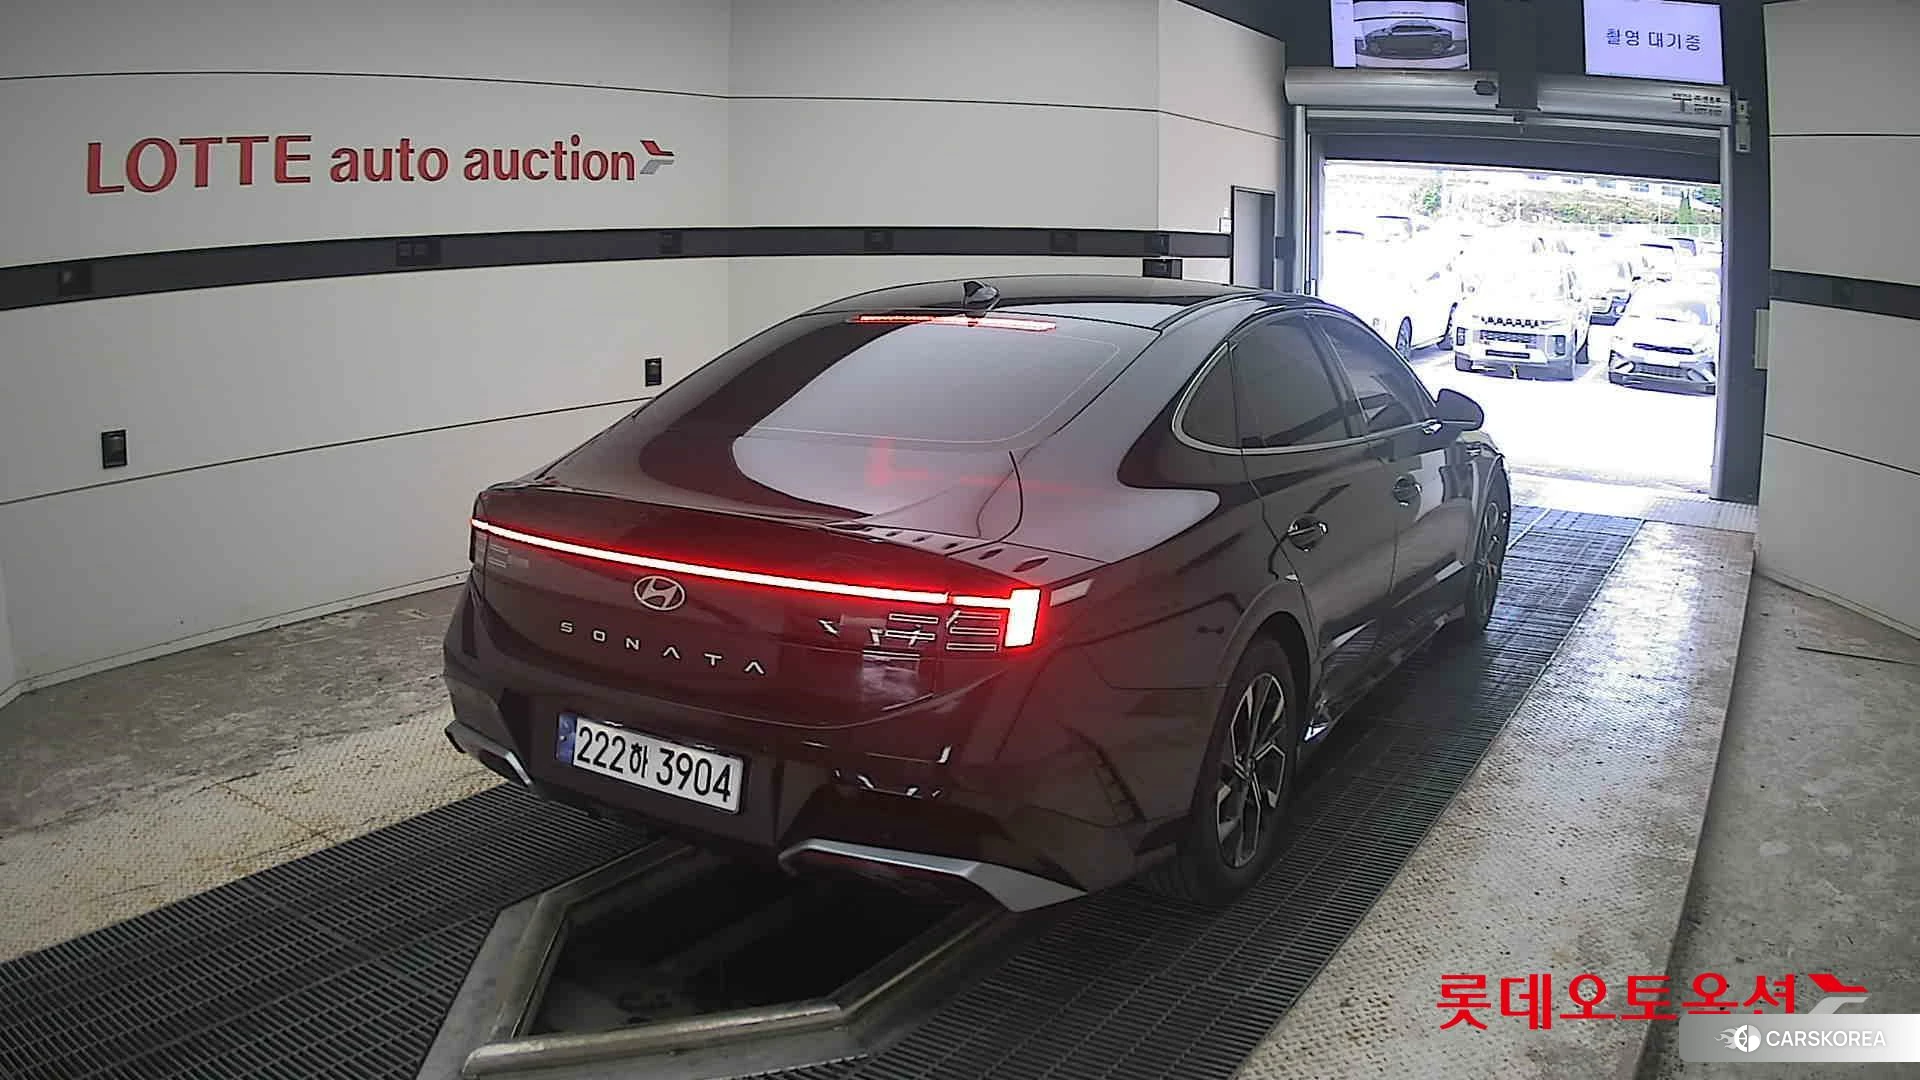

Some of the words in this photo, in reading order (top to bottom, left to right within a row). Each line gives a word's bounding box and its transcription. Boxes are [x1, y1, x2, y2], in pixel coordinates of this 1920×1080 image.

[1647, 31, 1701, 52] 대기중
[86, 134, 312, 194] LOTTE
[329, 138, 449, 182] auto
[463, 134, 635, 182] auction
[560, 621, 765, 675] SONATA
[576, 726, 649, 779] 222하
[656, 747, 732, 803] 3904
